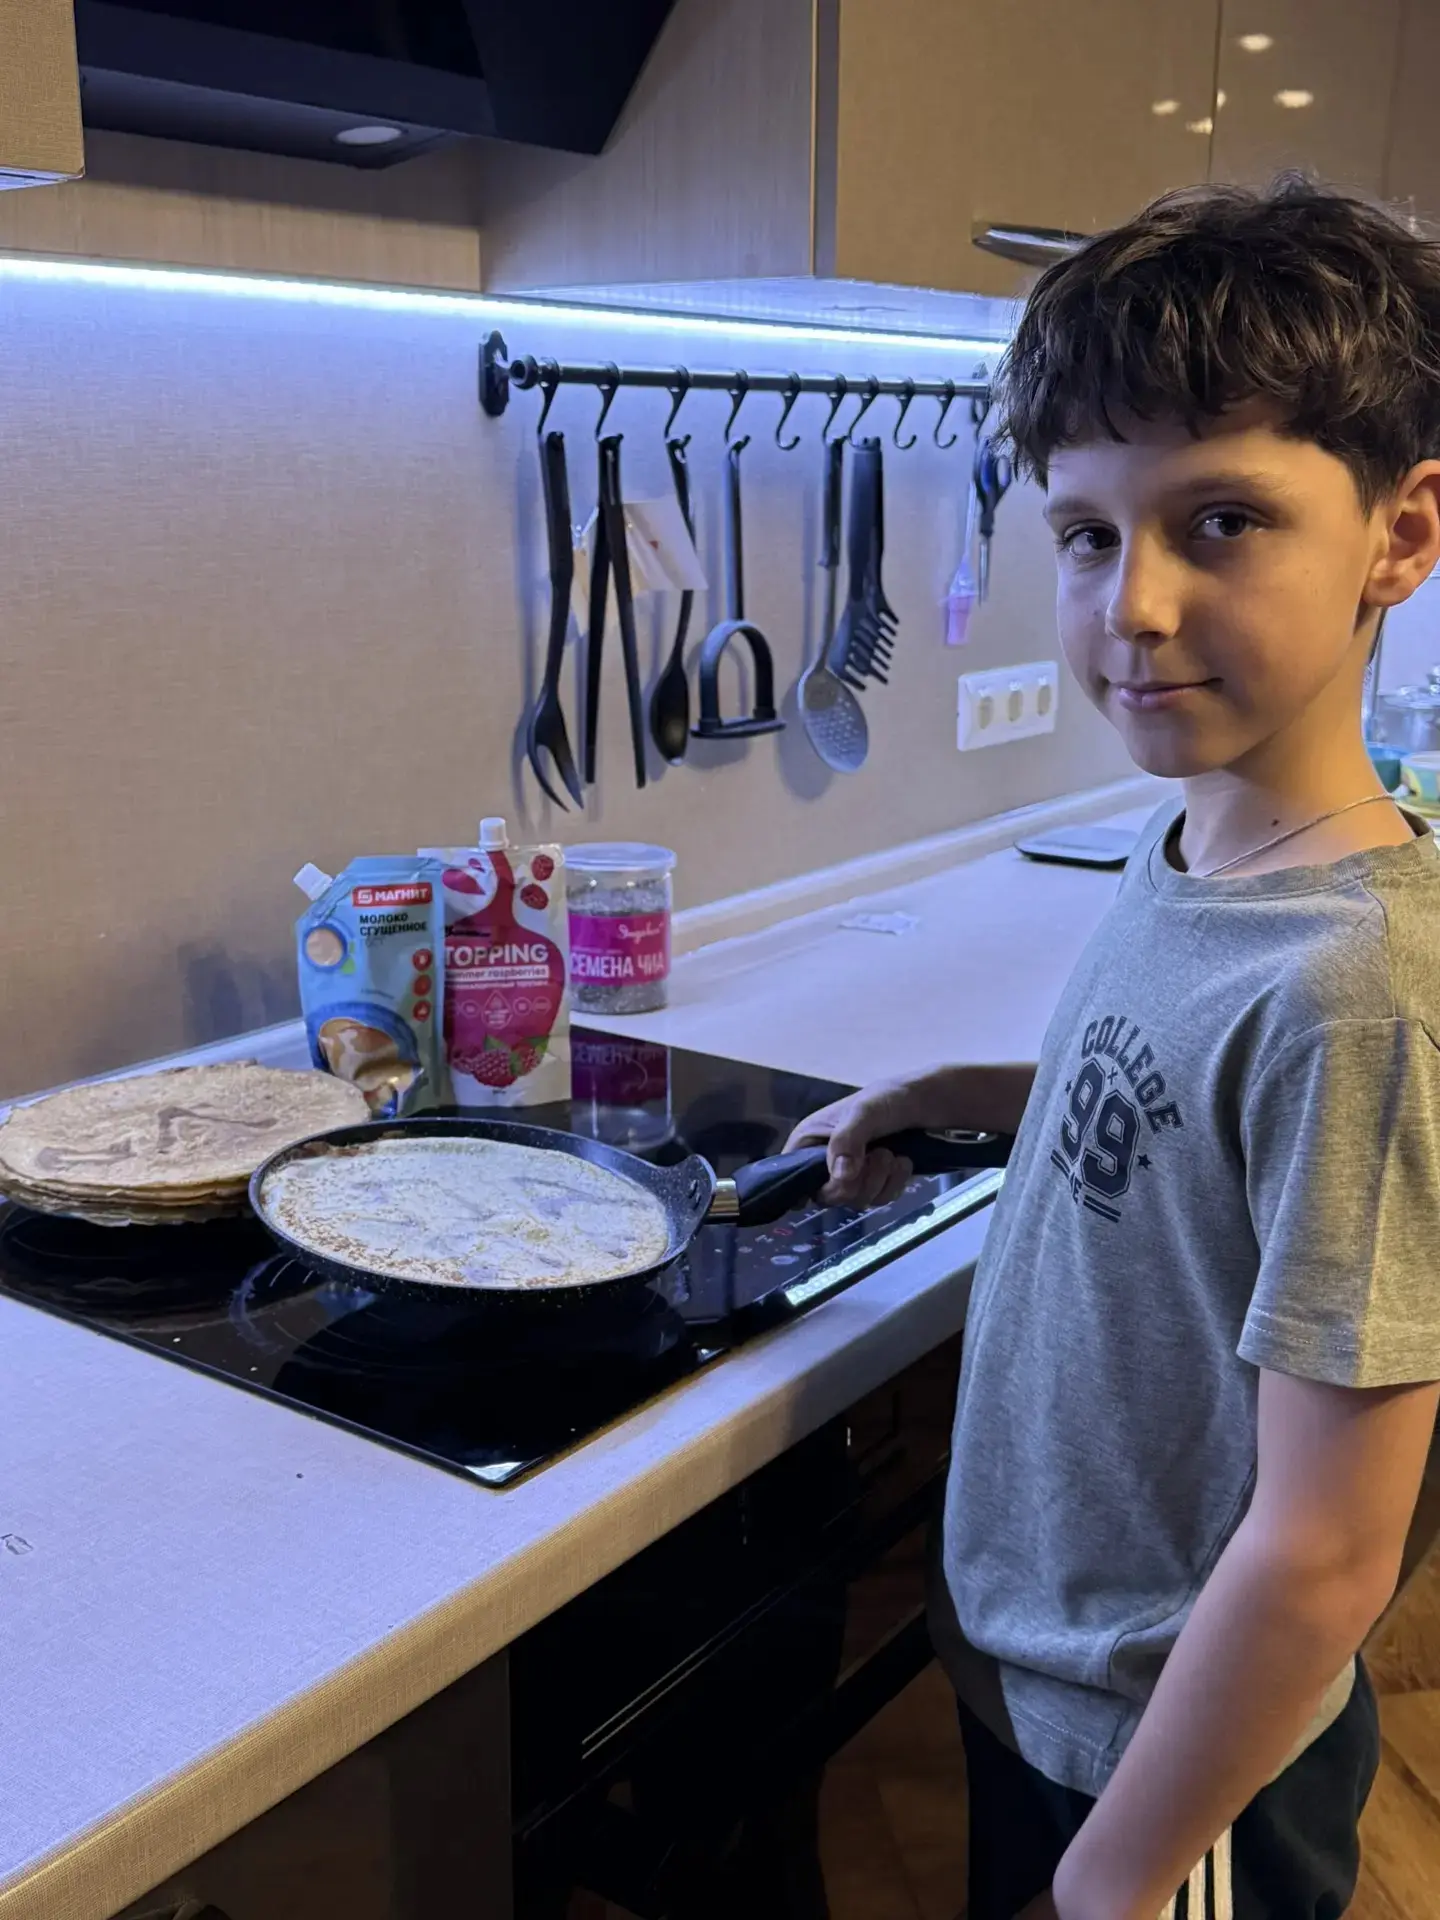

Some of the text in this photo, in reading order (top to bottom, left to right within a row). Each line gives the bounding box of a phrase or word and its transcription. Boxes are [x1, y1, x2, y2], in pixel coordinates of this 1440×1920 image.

[375, 888, 428, 902] МАГНИТ
[360, 912, 408, 924] МОЛОКО
[445, 943, 549, 966] TOPPING
[571, 951, 664, 978] СЕМЕНА ЧИА
[1081, 1015, 1184, 1135] COLLEGE
[1060, 1057, 1140, 1199] 99
